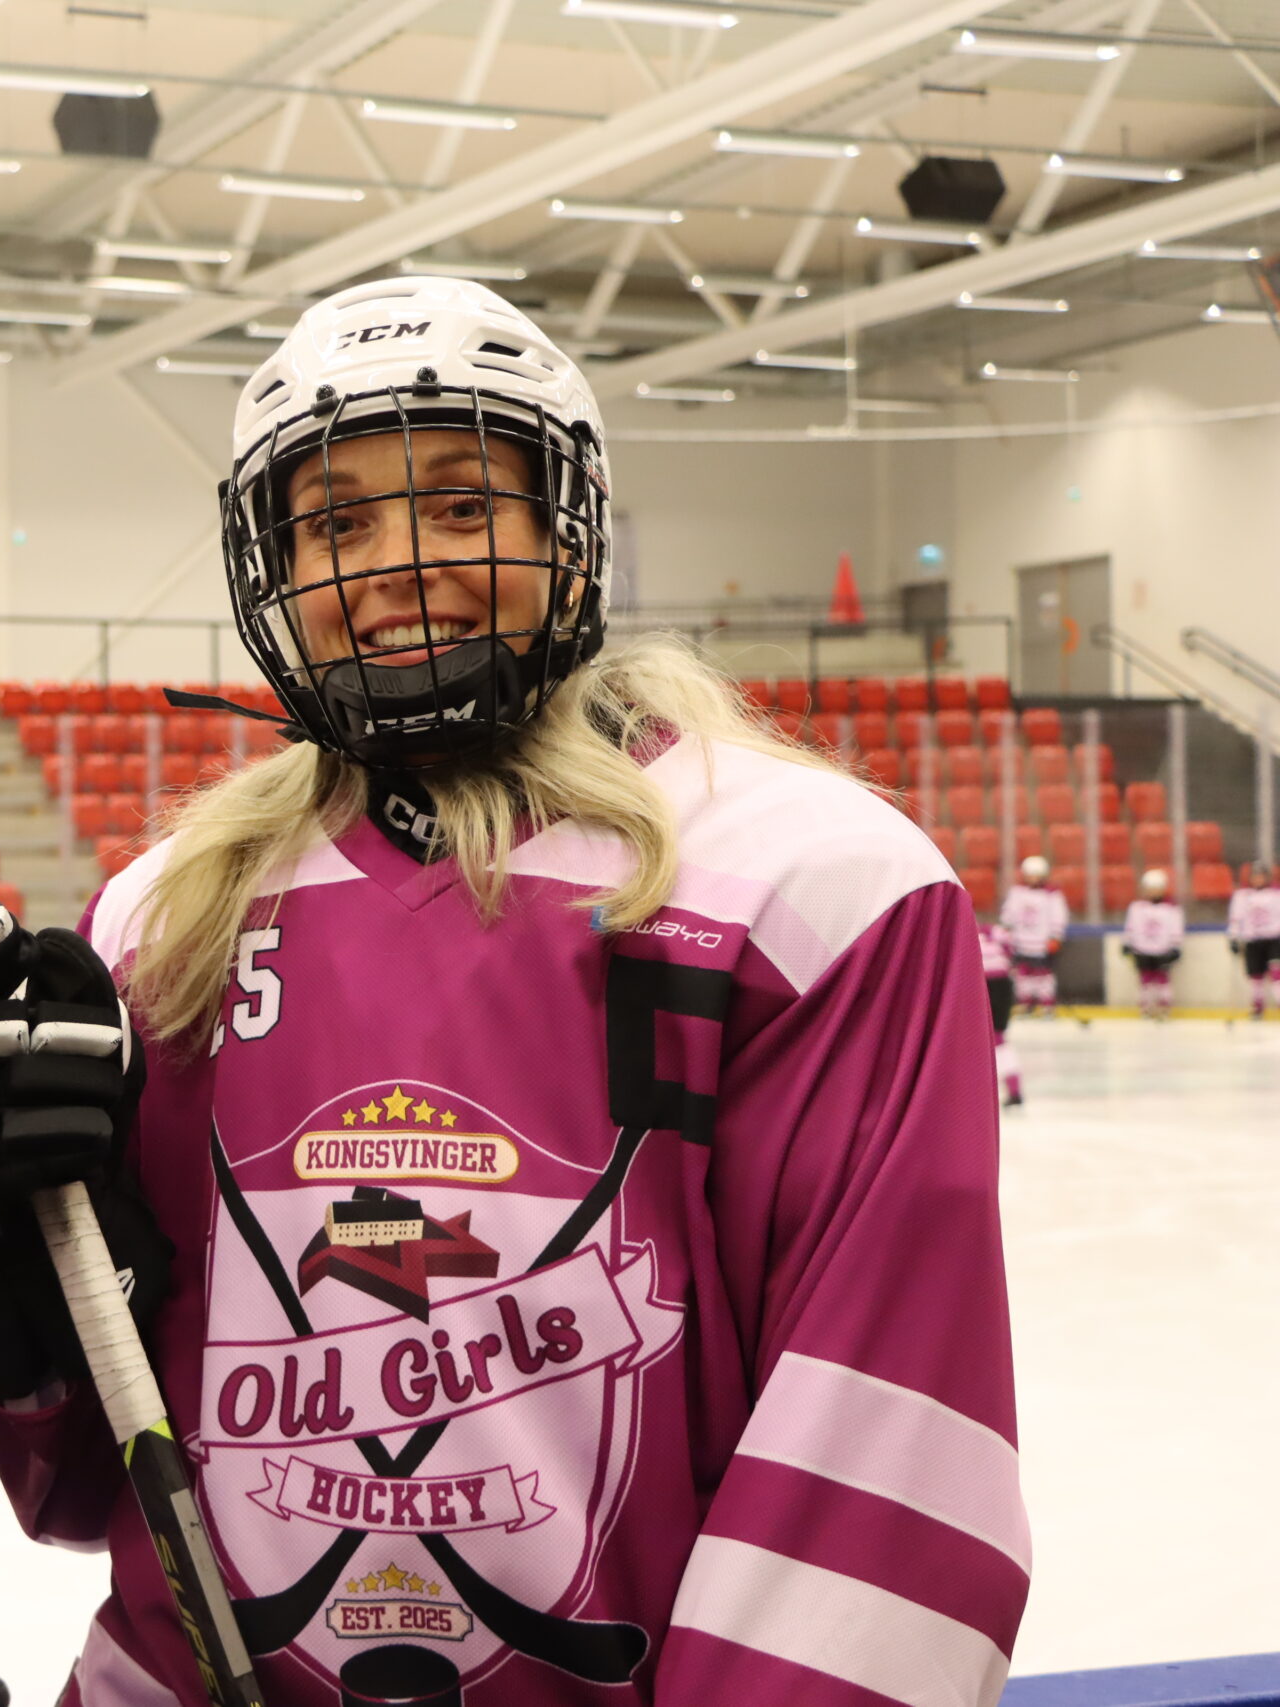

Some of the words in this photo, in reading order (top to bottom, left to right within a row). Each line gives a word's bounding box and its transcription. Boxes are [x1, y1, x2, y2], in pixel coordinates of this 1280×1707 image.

[305, 1138, 498, 1174] KONGSVINGER
[217, 1346, 355, 1438] Old
[380, 1293, 583, 1418] Girls
[306, 1467, 487, 1527] HOCKEY
[340, 1606, 393, 1631] EST.
[399, 1606, 453, 1633] 2025
